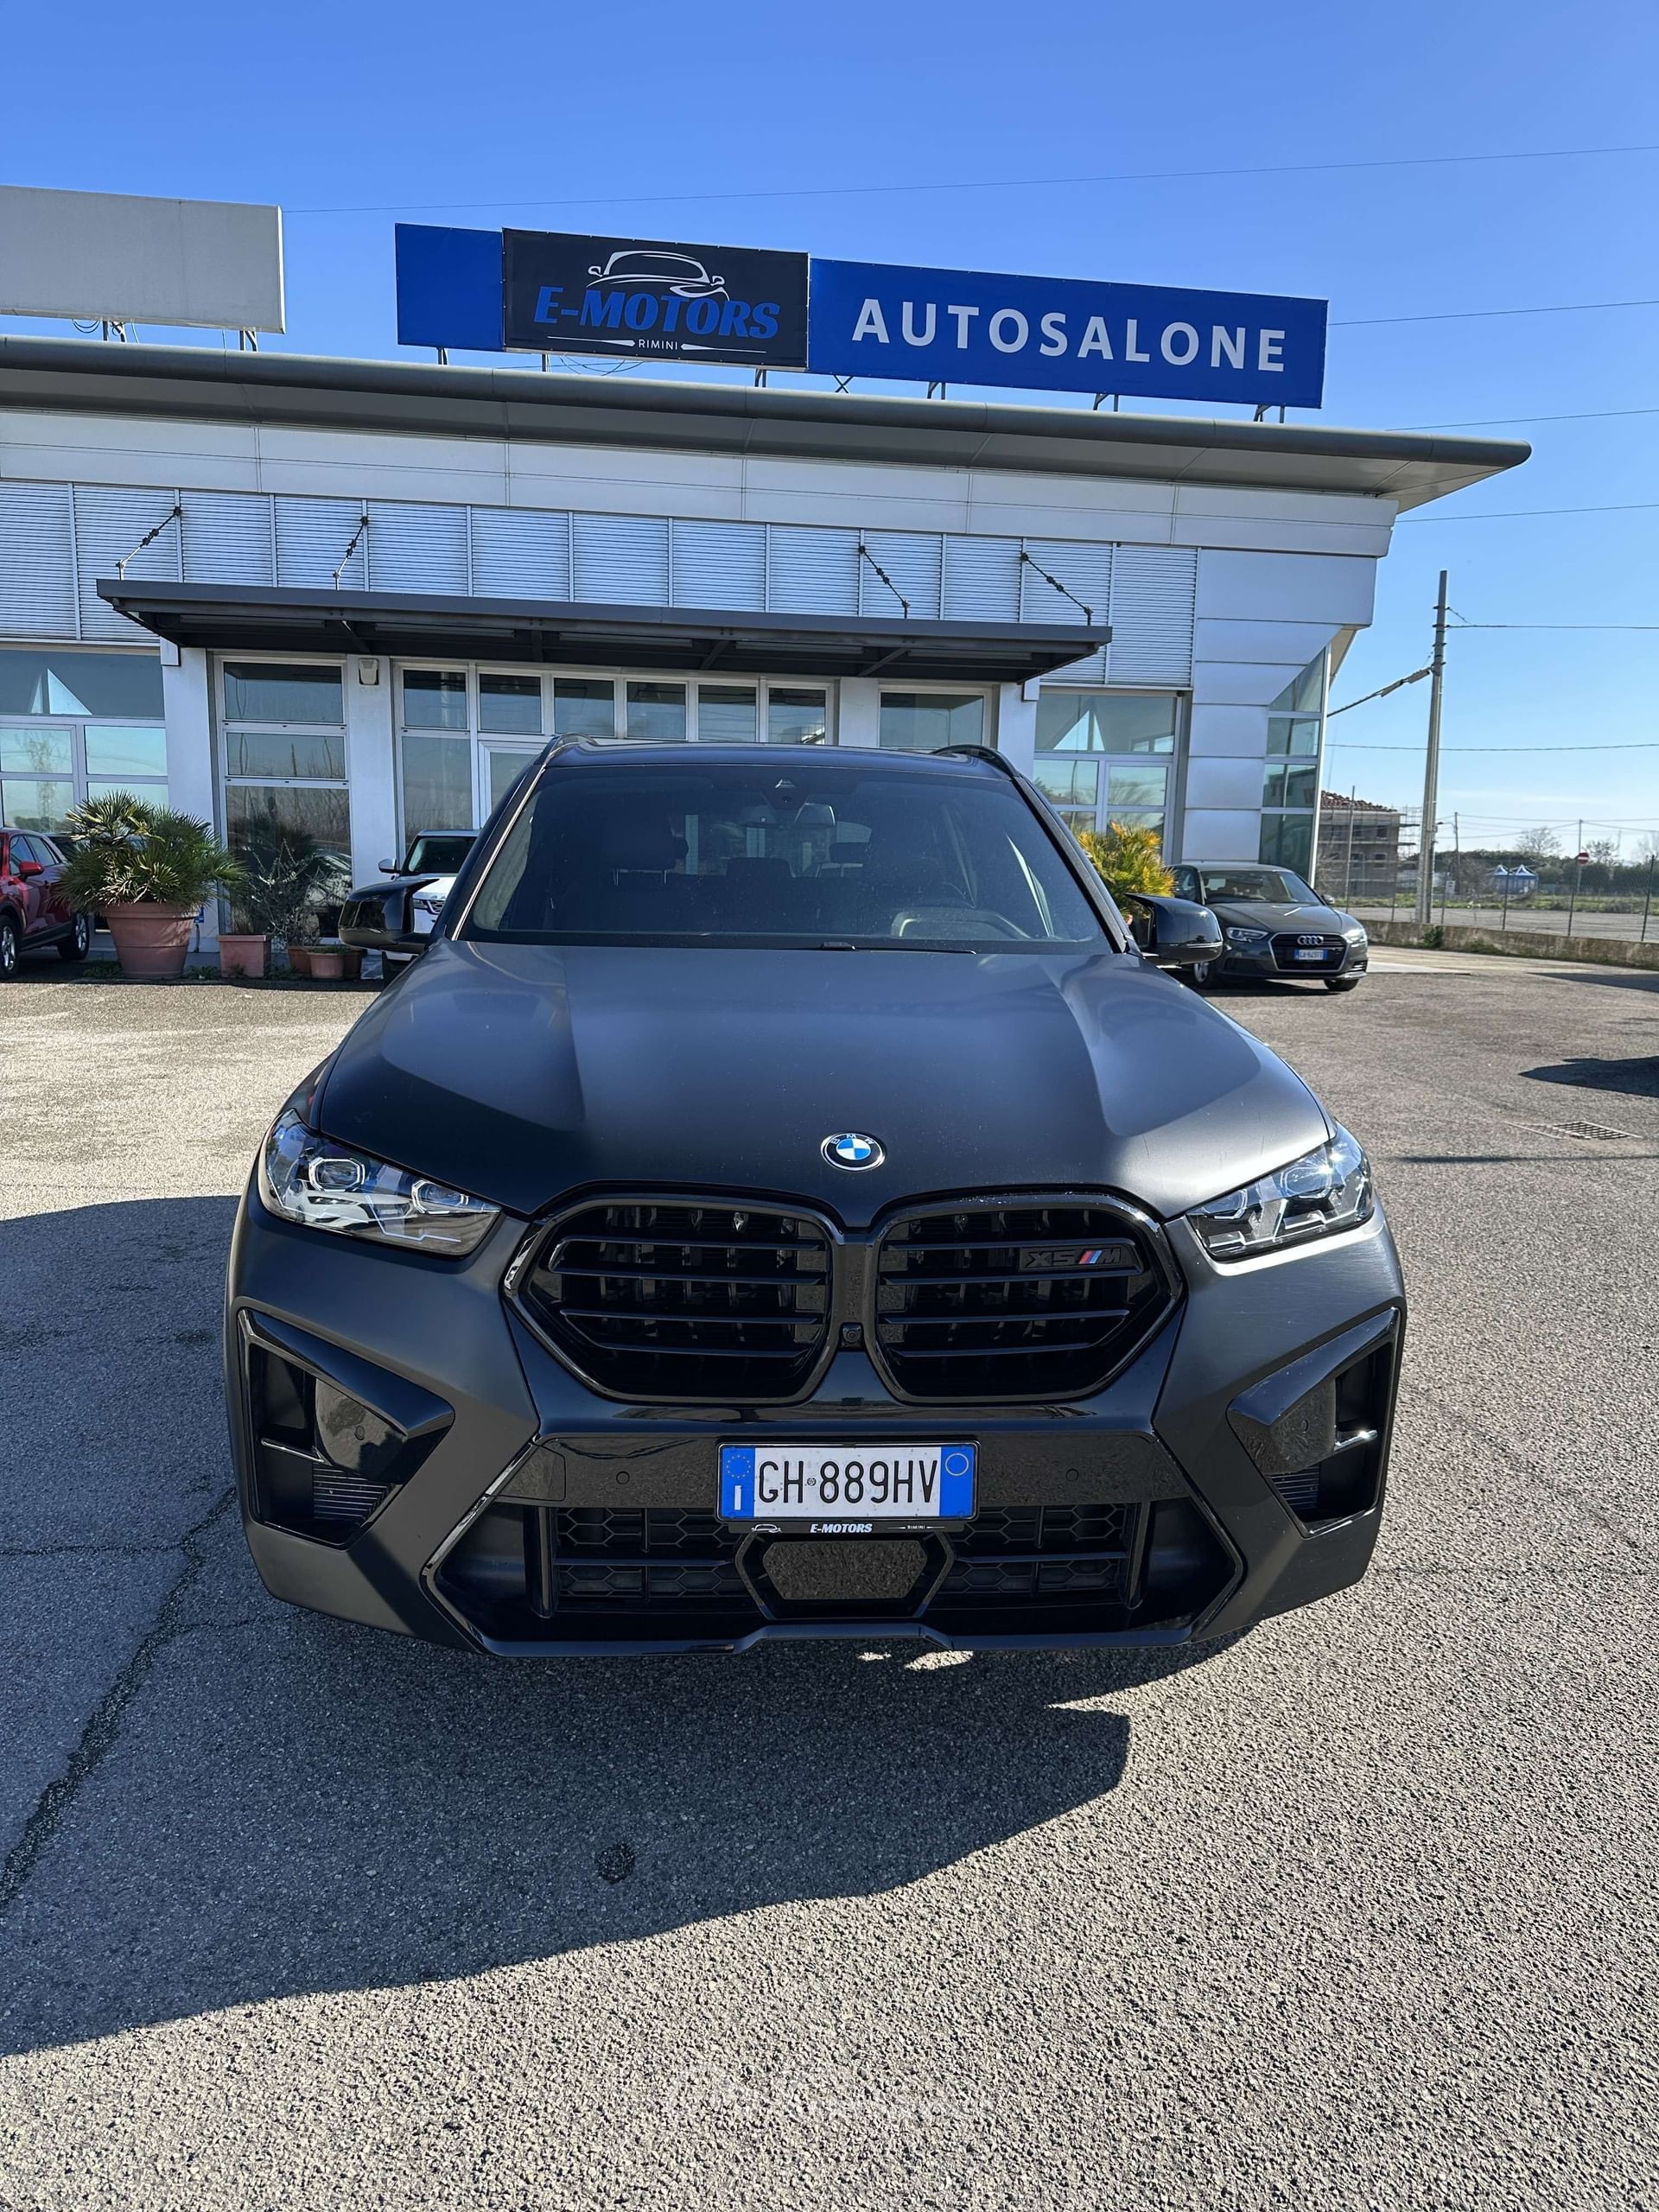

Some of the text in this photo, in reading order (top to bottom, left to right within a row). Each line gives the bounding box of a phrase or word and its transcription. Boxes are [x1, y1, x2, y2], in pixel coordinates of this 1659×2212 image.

[533, 285, 780, 340] E-MOTORS
[852, 298, 1286, 372] AUTOSALONE
[638, 338, 678, 351] RIMINI
[830, 1133, 875, 1145] BMW
[810, 1522, 873, 1534] E-MOTORS
